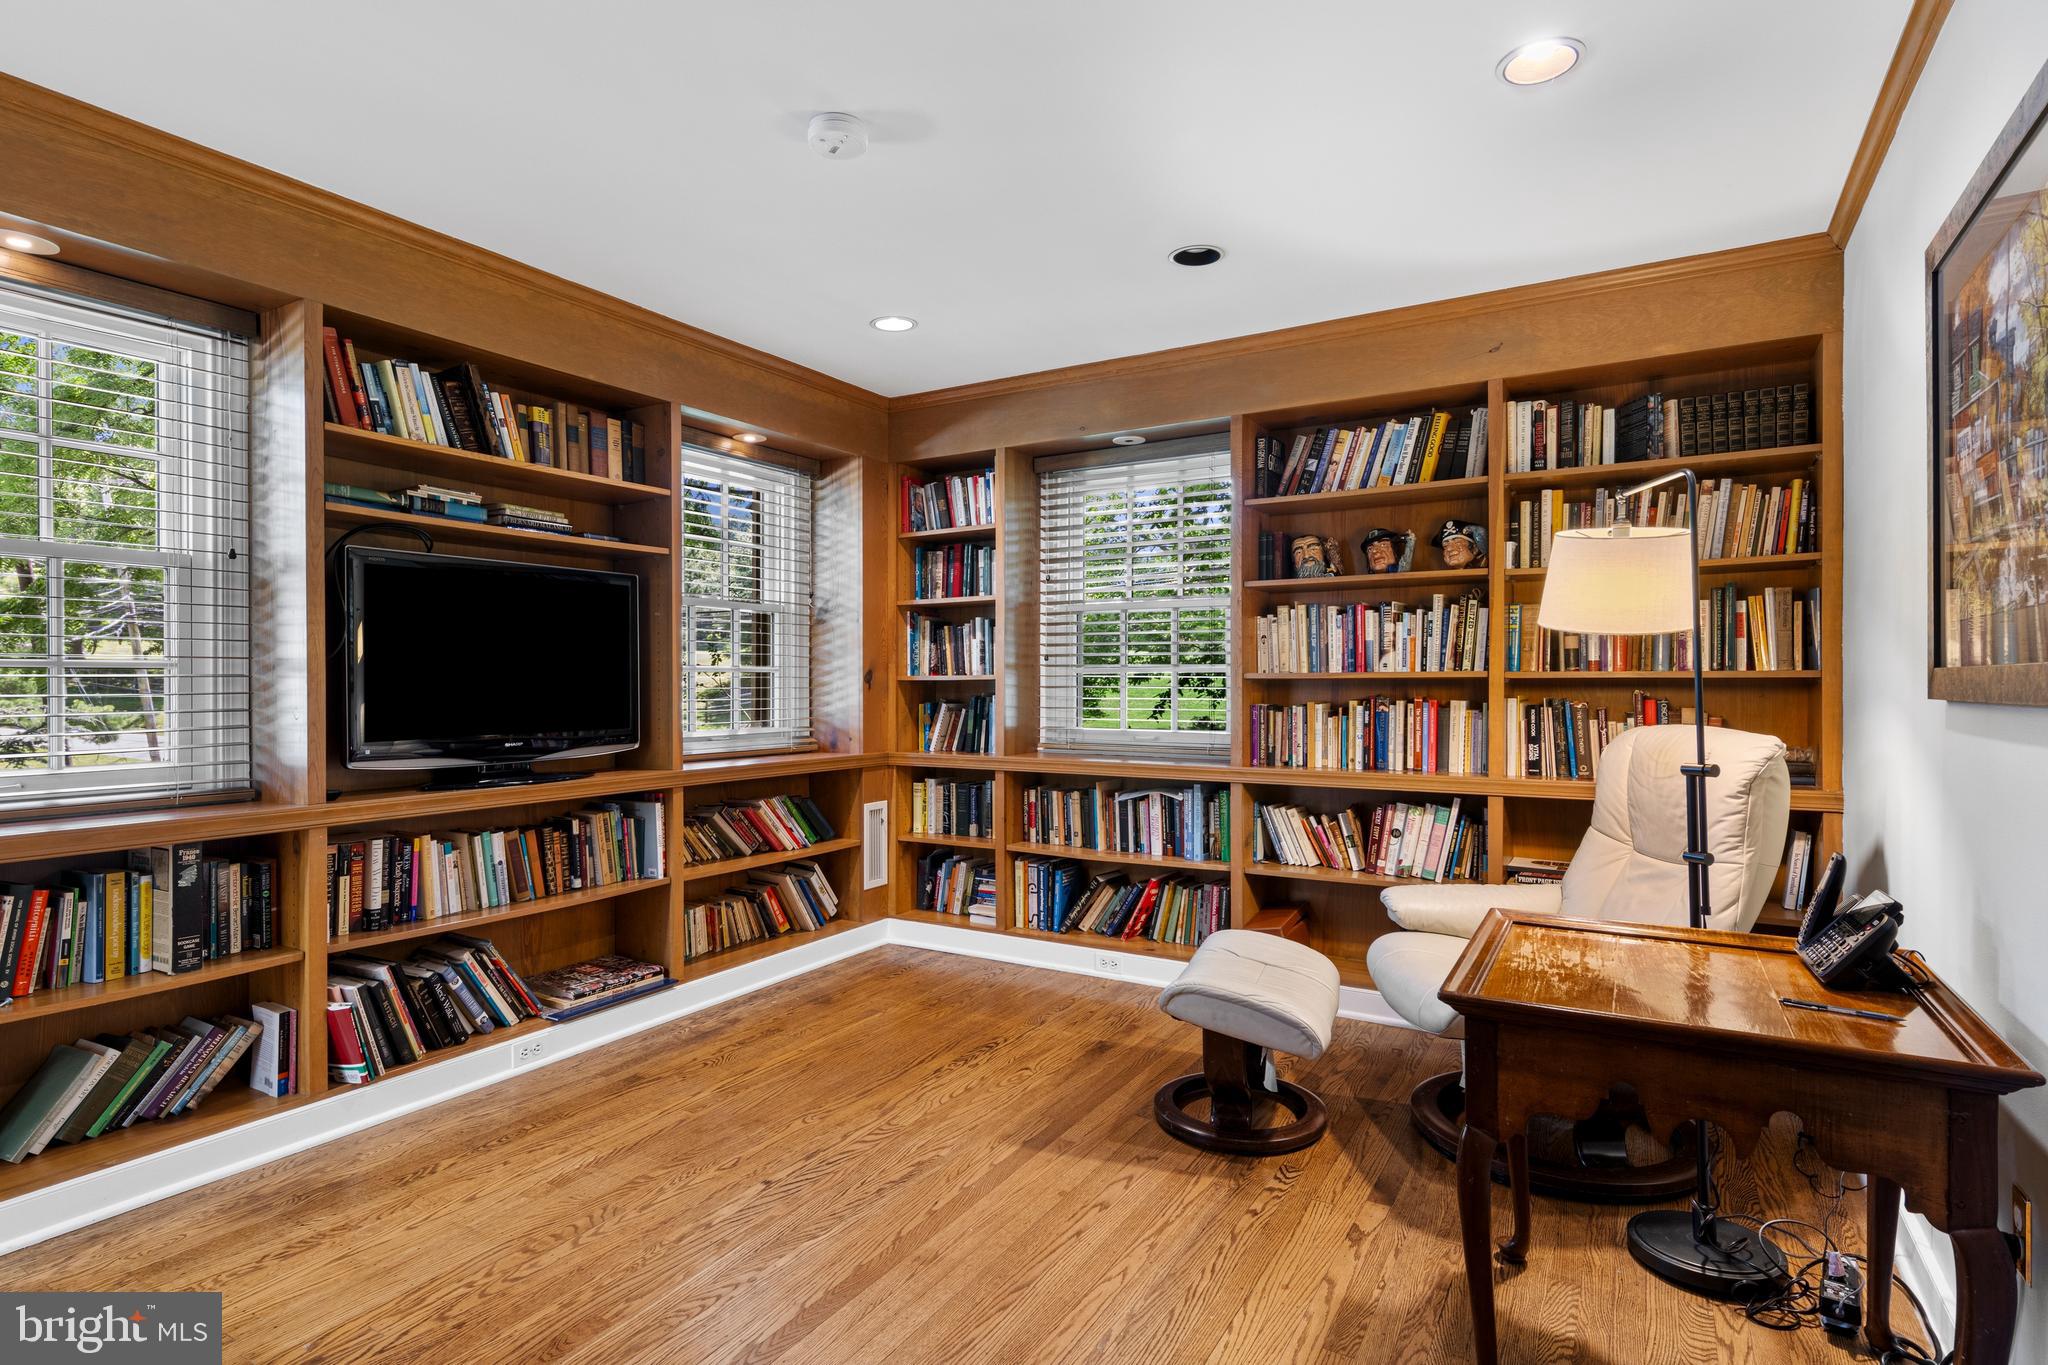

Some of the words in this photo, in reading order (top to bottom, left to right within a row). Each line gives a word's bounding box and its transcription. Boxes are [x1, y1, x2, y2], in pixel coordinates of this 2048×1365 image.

[432, 376, 443, 398] THOMAS
[440, 398, 451, 421] HARRIS
[1431, 415, 1441, 439] FEELING
[1427, 439, 1436, 458] GOOD
[1535, 423, 1544, 458] UNDERBOSS
[1468, 603, 1476, 629] BLITZED
[373, 843, 381, 864] How
[403, 846, 411, 870] PRINCESS
[353, 863, 362, 874] THE
[373, 869, 380, 884] We
[394, 861, 402, 878] Deadly
[352, 876, 362, 912] WHISPERERS
[372, 887, 380, 904] Die
[394, 879, 402, 906] Masquerade
[1789, 874, 1798, 896] Parenthood
[433, 982, 448, 1002] Alex's
[441, 1000, 456, 1019] Wake
[381, 1000, 399, 1029] KITSCH
